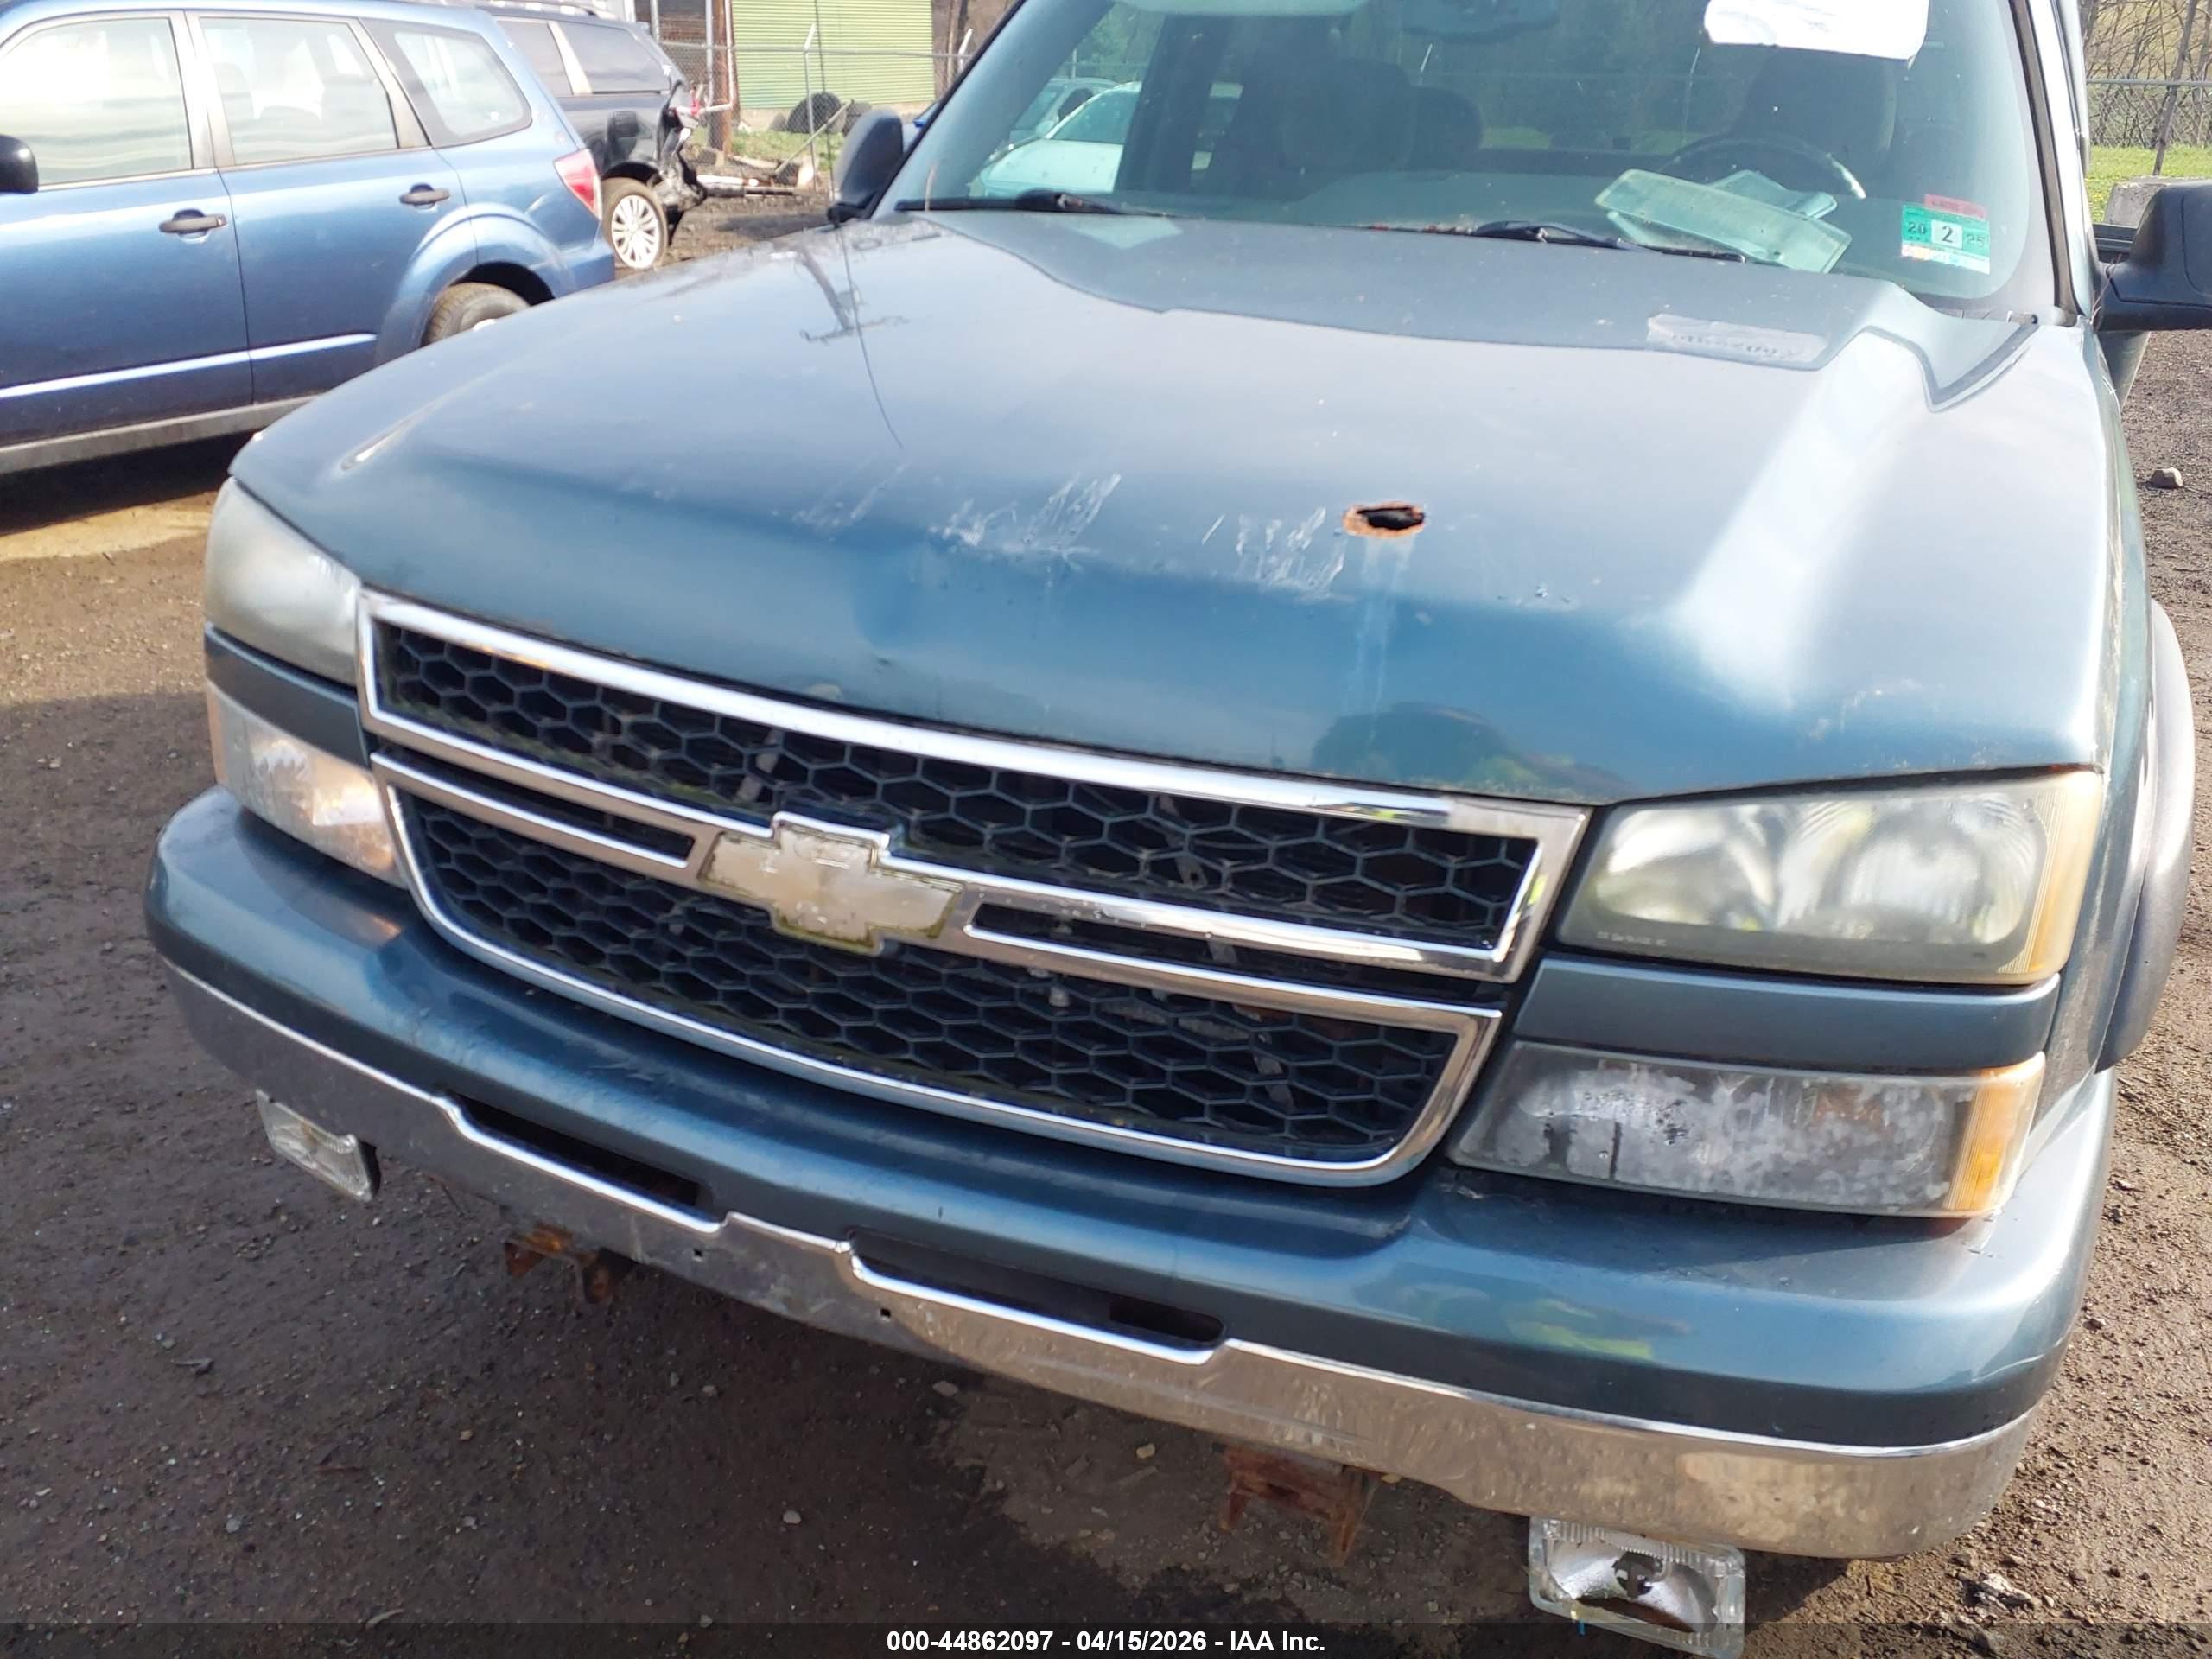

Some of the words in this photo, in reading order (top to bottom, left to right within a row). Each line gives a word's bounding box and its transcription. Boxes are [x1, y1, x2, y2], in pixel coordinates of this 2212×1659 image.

[1907, 221, 1927, 235] 20
[1942, 225, 1954, 243] 2
[1966, 233, 1986, 248] 25
